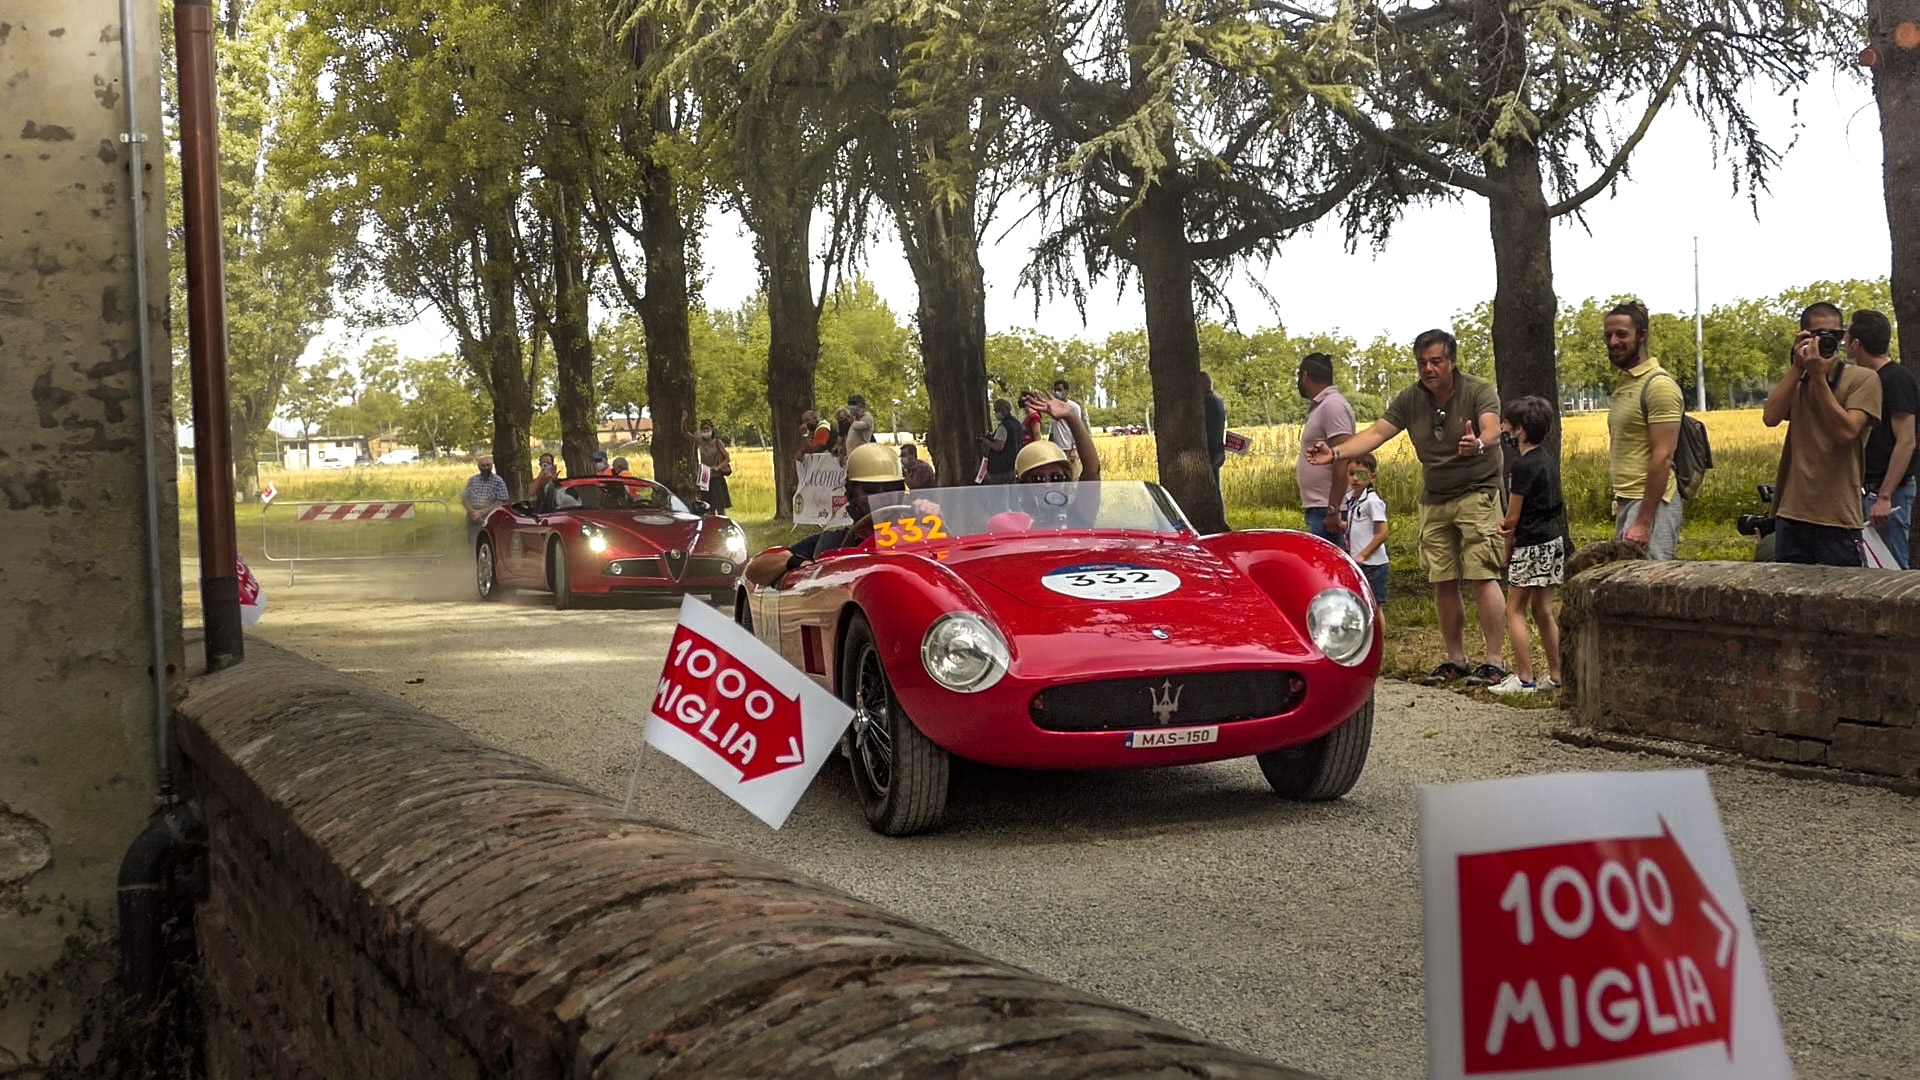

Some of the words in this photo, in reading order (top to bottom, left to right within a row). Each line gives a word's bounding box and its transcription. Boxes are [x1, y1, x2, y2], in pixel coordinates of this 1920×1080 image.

[874, 515, 948, 547] 332
[1066, 572, 1157, 586] 332
[674, 639, 774, 720] 1000
[657, 677, 757, 765] MIGLIA
[1141, 730, 1210, 746] MAS-150
[1500, 858, 1674, 945] 1000
[1485, 955, 1716, 1055] MIGLIA
